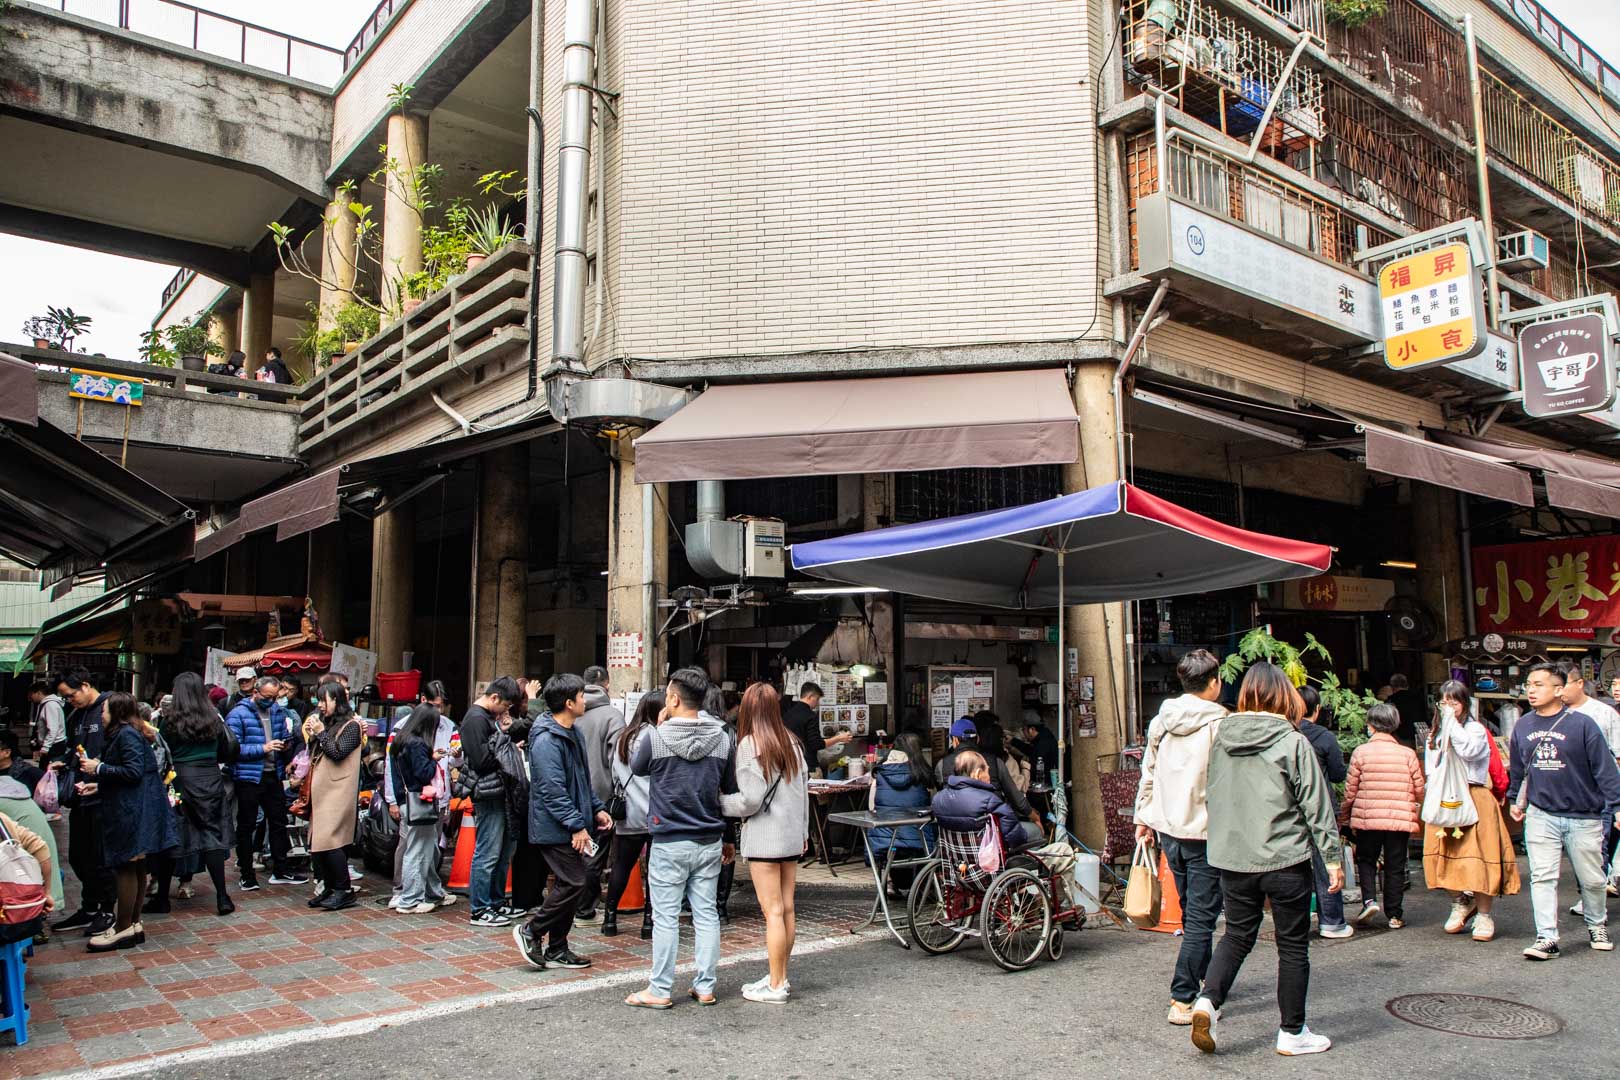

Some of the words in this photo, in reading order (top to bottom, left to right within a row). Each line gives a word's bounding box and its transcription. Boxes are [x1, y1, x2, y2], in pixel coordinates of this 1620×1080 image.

[1190, 234, 1203, 246] 104
[1389, 252, 1456, 290] 福昇
[1394, 295, 1459, 321] 花枝米粉
[1397, 329, 1464, 361] 小食
[1547, 362, 1582, 381] 宇哥
